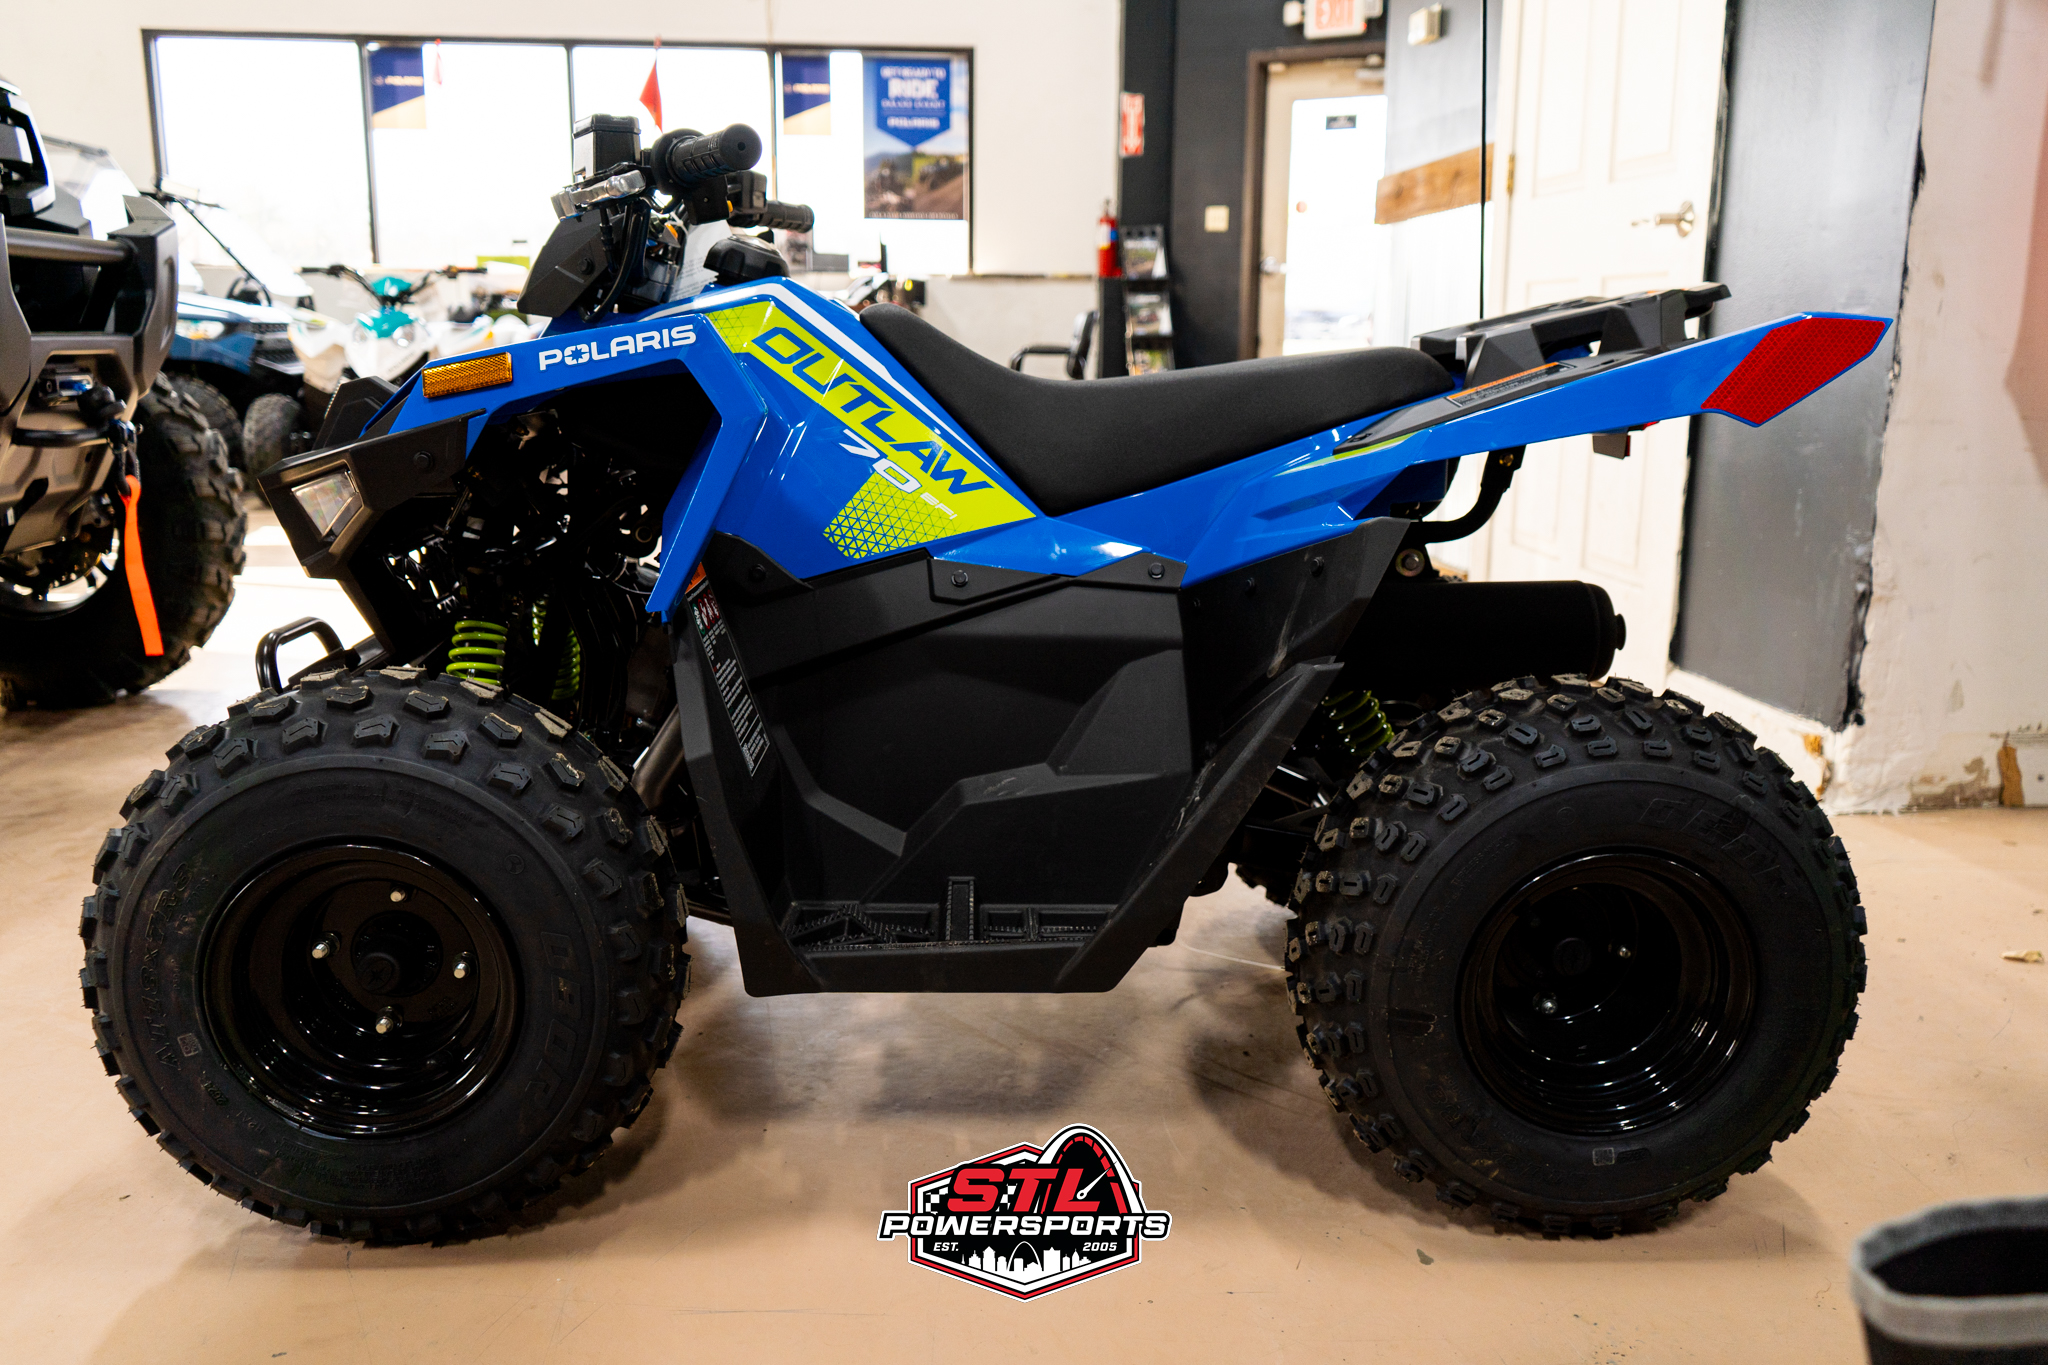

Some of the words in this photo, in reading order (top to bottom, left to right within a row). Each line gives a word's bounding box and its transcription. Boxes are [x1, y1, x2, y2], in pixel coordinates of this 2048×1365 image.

[538, 324, 697, 371] POLARIS
[751, 326, 996, 495] OUTLAW
[838, 428, 922, 494] 70
[919, 491, 958, 520] EFI
